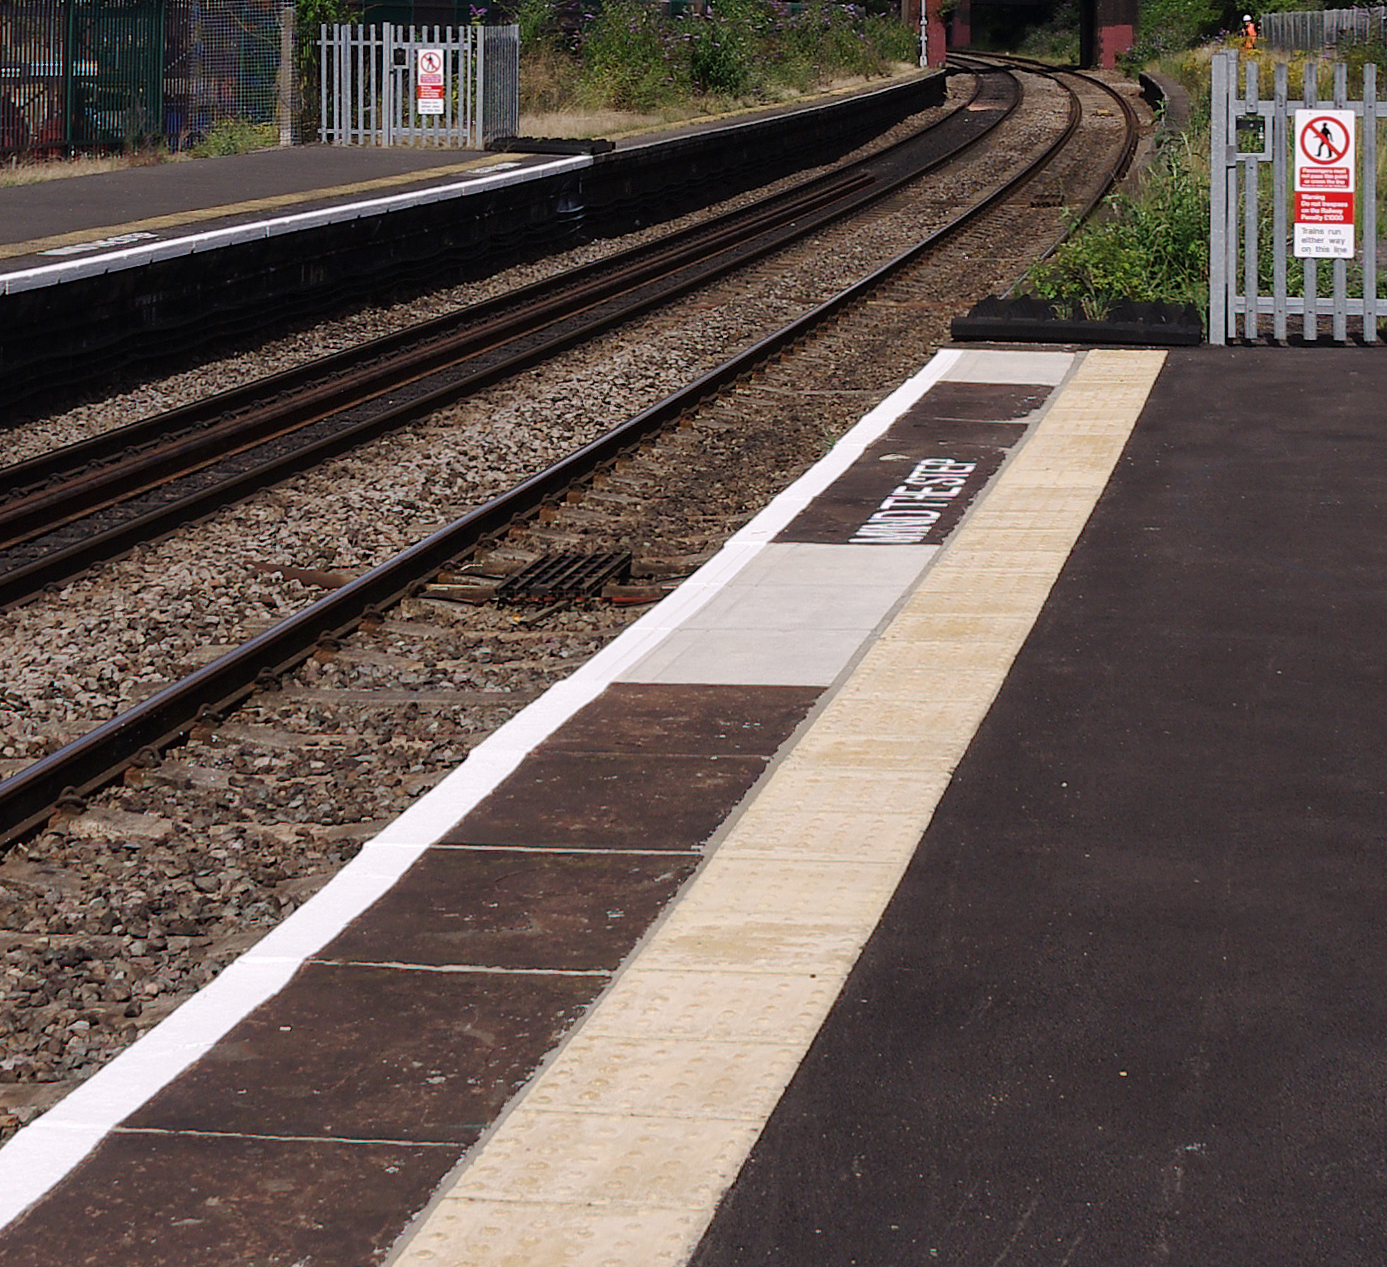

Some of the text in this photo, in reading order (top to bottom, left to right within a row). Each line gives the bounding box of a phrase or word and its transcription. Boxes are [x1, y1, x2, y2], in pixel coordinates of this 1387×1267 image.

[1320, 207, 1343, 215] Railway
[848, 458, 977, 544] MIND THE STEP
